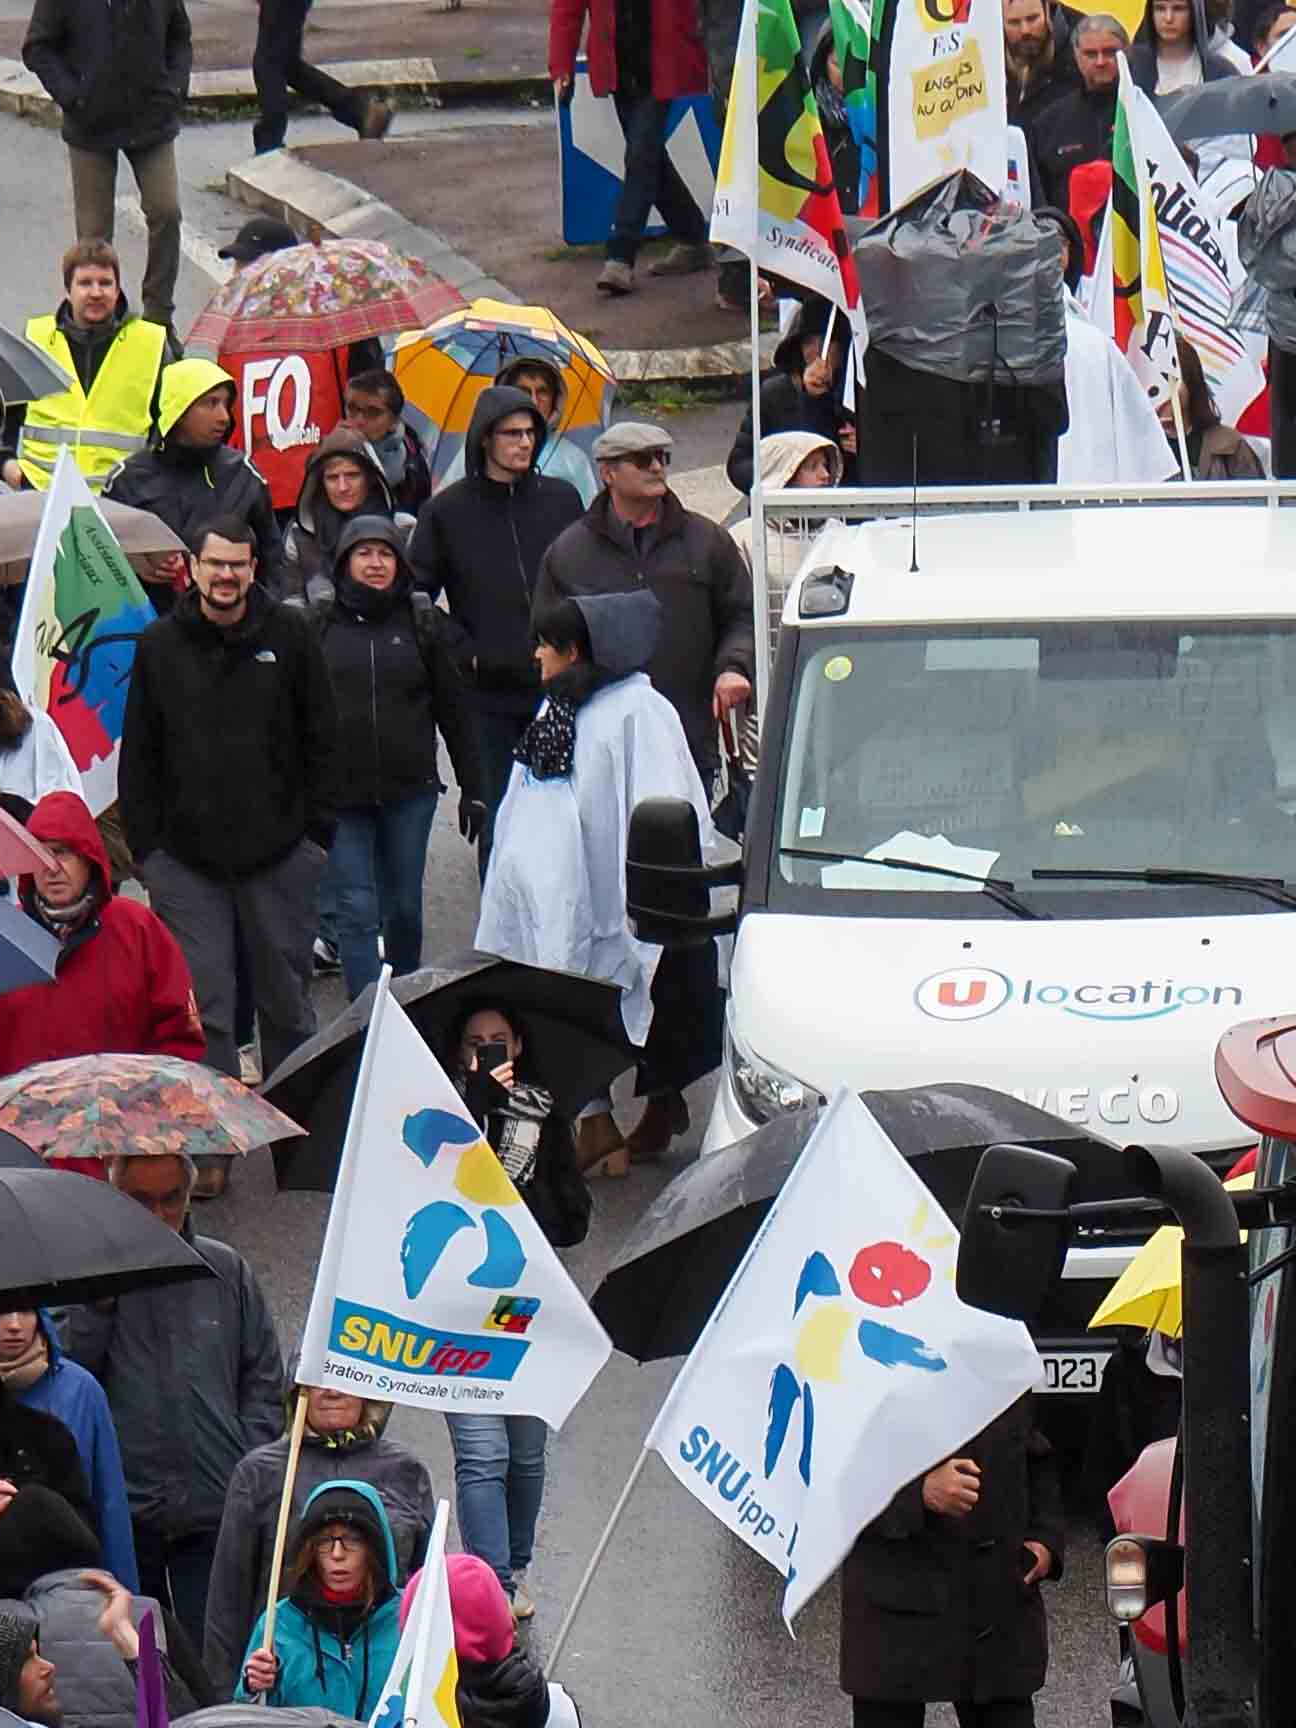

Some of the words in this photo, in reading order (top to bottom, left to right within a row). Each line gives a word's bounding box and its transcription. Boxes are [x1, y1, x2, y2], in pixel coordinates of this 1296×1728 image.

[1022, 978, 1242, 1005] location
[339, 1316, 492, 1376] SNUipp
[376, 1374, 449, 1398] Syndicale
[451, 1385, 505, 1402] Unitaire
